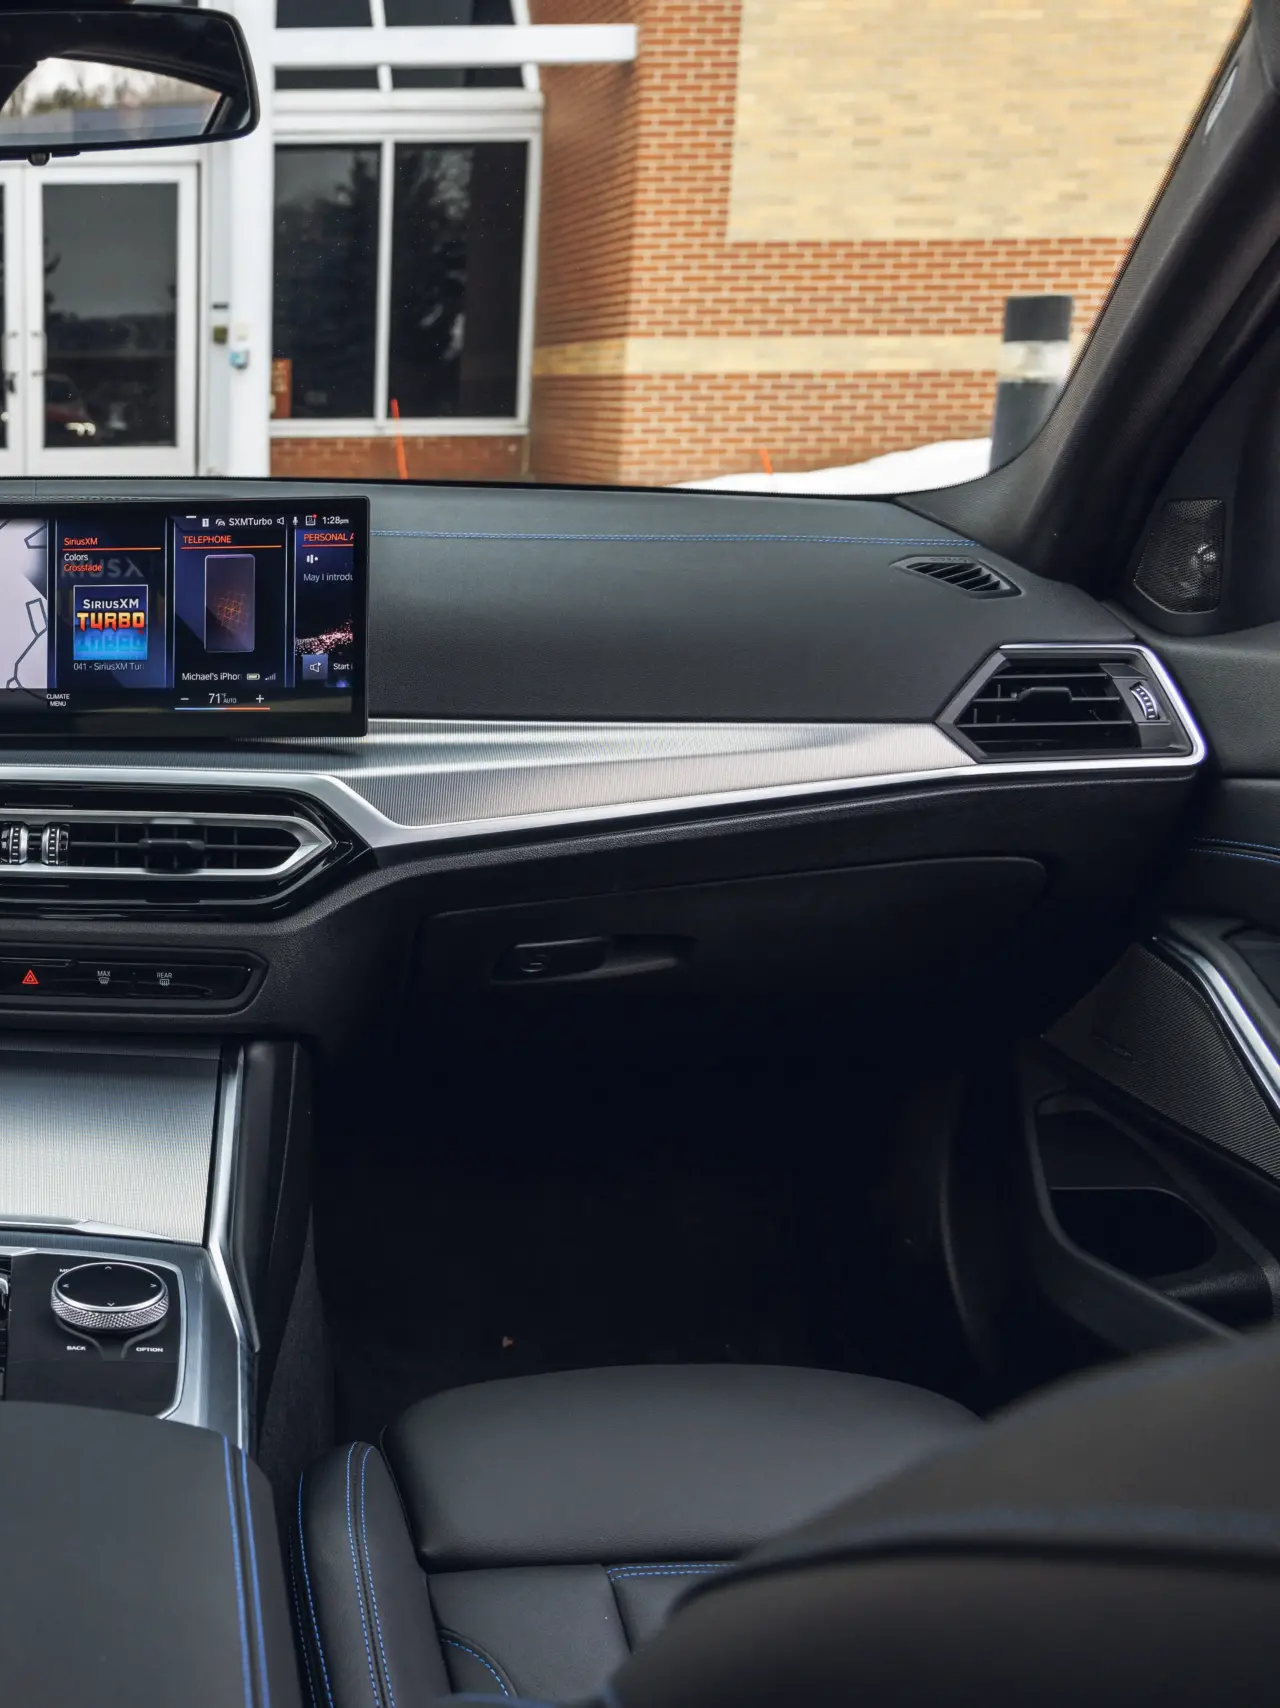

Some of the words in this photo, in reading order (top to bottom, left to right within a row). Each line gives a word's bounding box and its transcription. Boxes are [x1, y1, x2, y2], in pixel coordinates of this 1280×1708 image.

[228, 517, 273, 526] SXMTurbo
[322, 516, 349, 525] 1:28pm
[63, 537, 98, 546] SiriusXM
[183, 535, 232, 544] TELEPHONE
[303, 533, 348, 541] PERSONAL
[63, 553, 89, 561] Colors
[63, 563, 103, 572] Crossfade
[303, 573, 320, 583] May
[76, 611, 145, 632] TURBO
[73, 663, 87, 671] 041
[93, 662, 128, 671] SiriusXM
[130, 662, 145, 670] Tur
[333, 662, 349, 670] Start
[182, 672, 219, 681] Michael's
[208, 692, 221, 704] 71
